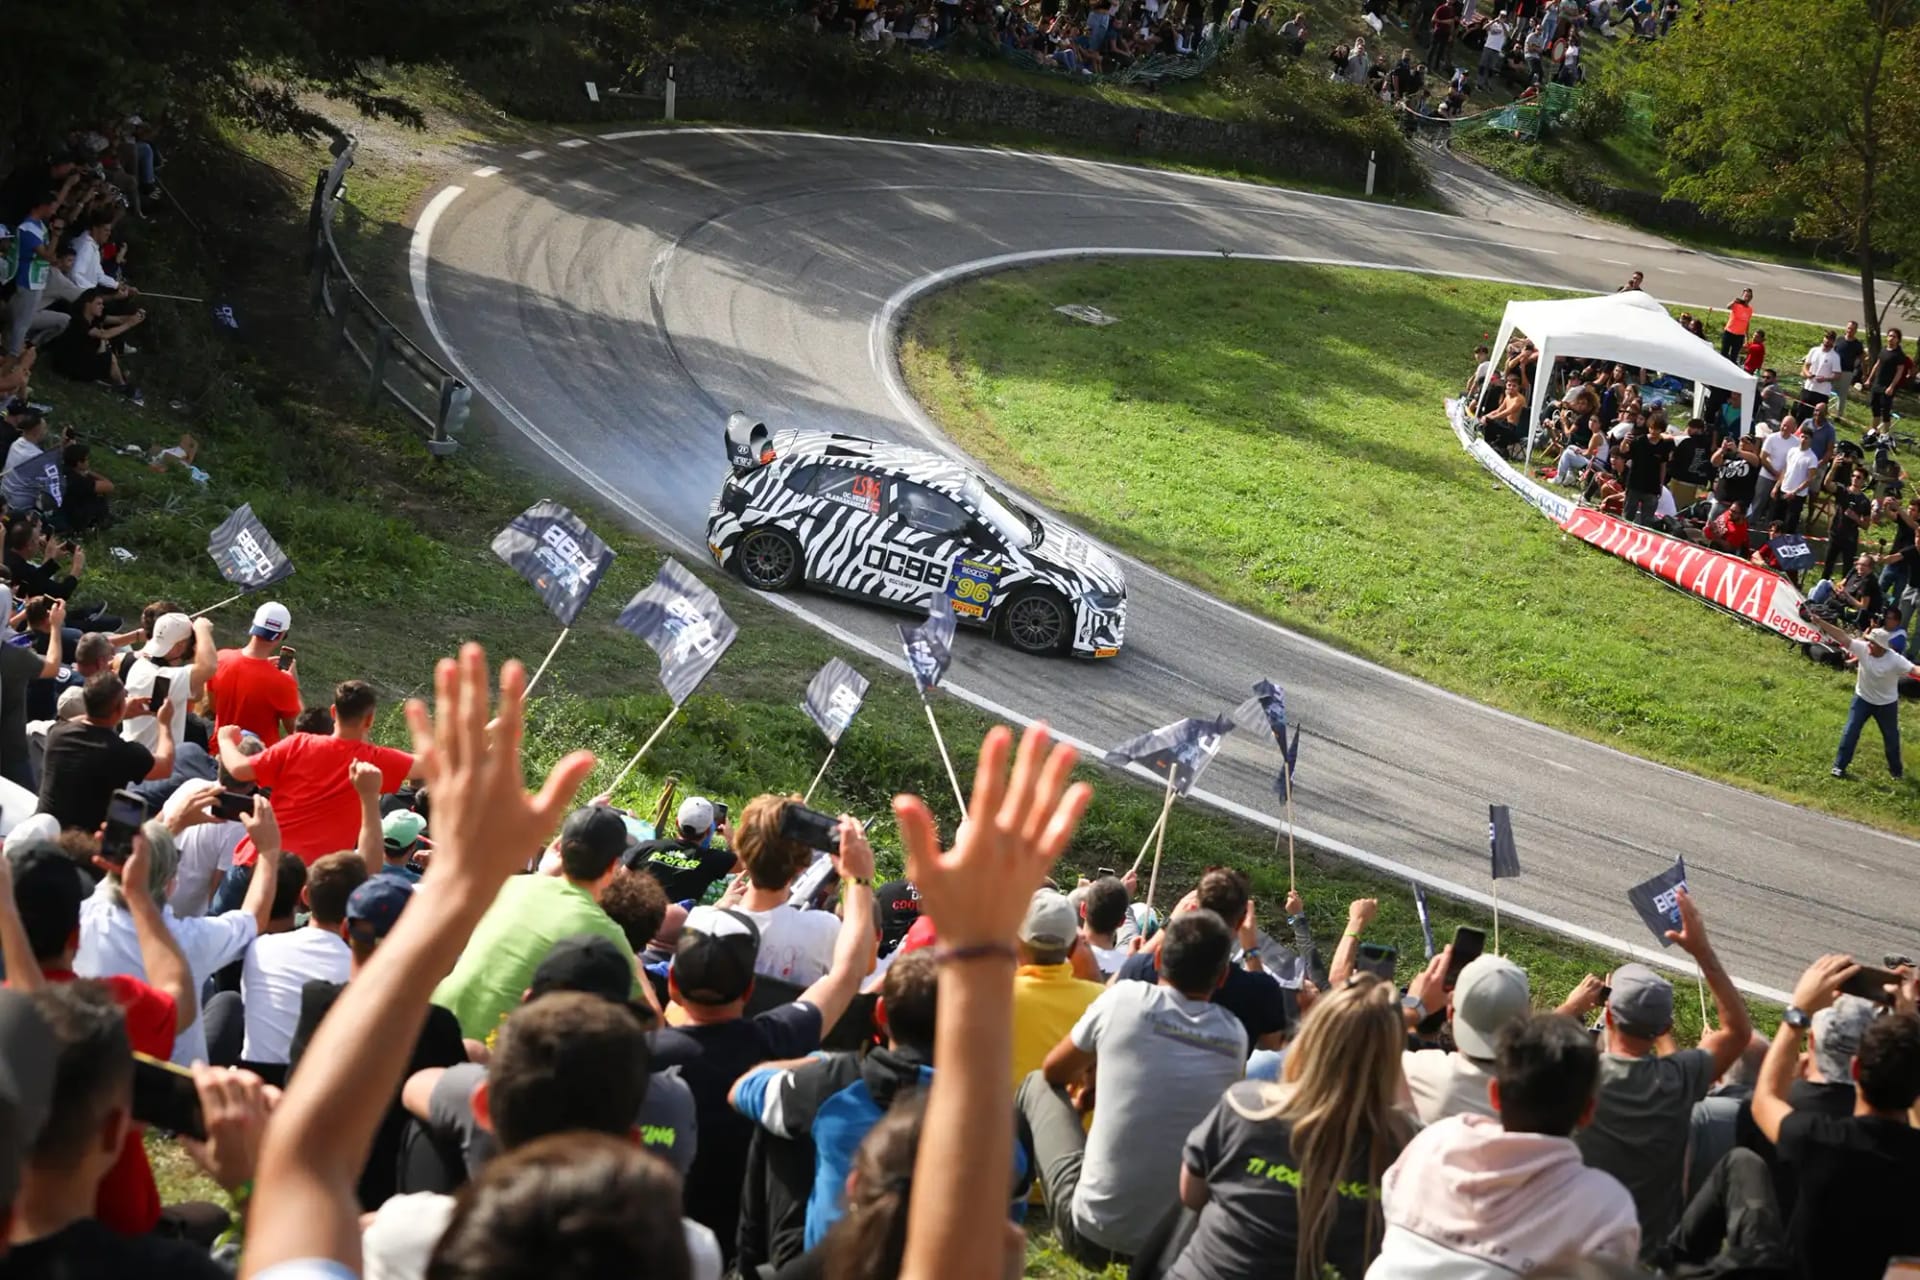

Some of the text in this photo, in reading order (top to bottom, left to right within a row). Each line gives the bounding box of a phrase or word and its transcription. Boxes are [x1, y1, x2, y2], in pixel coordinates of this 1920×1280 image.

[863, 544, 948, 588] OC96
[955, 578, 992, 602] 96
[1767, 609, 1822, 642] leggera
